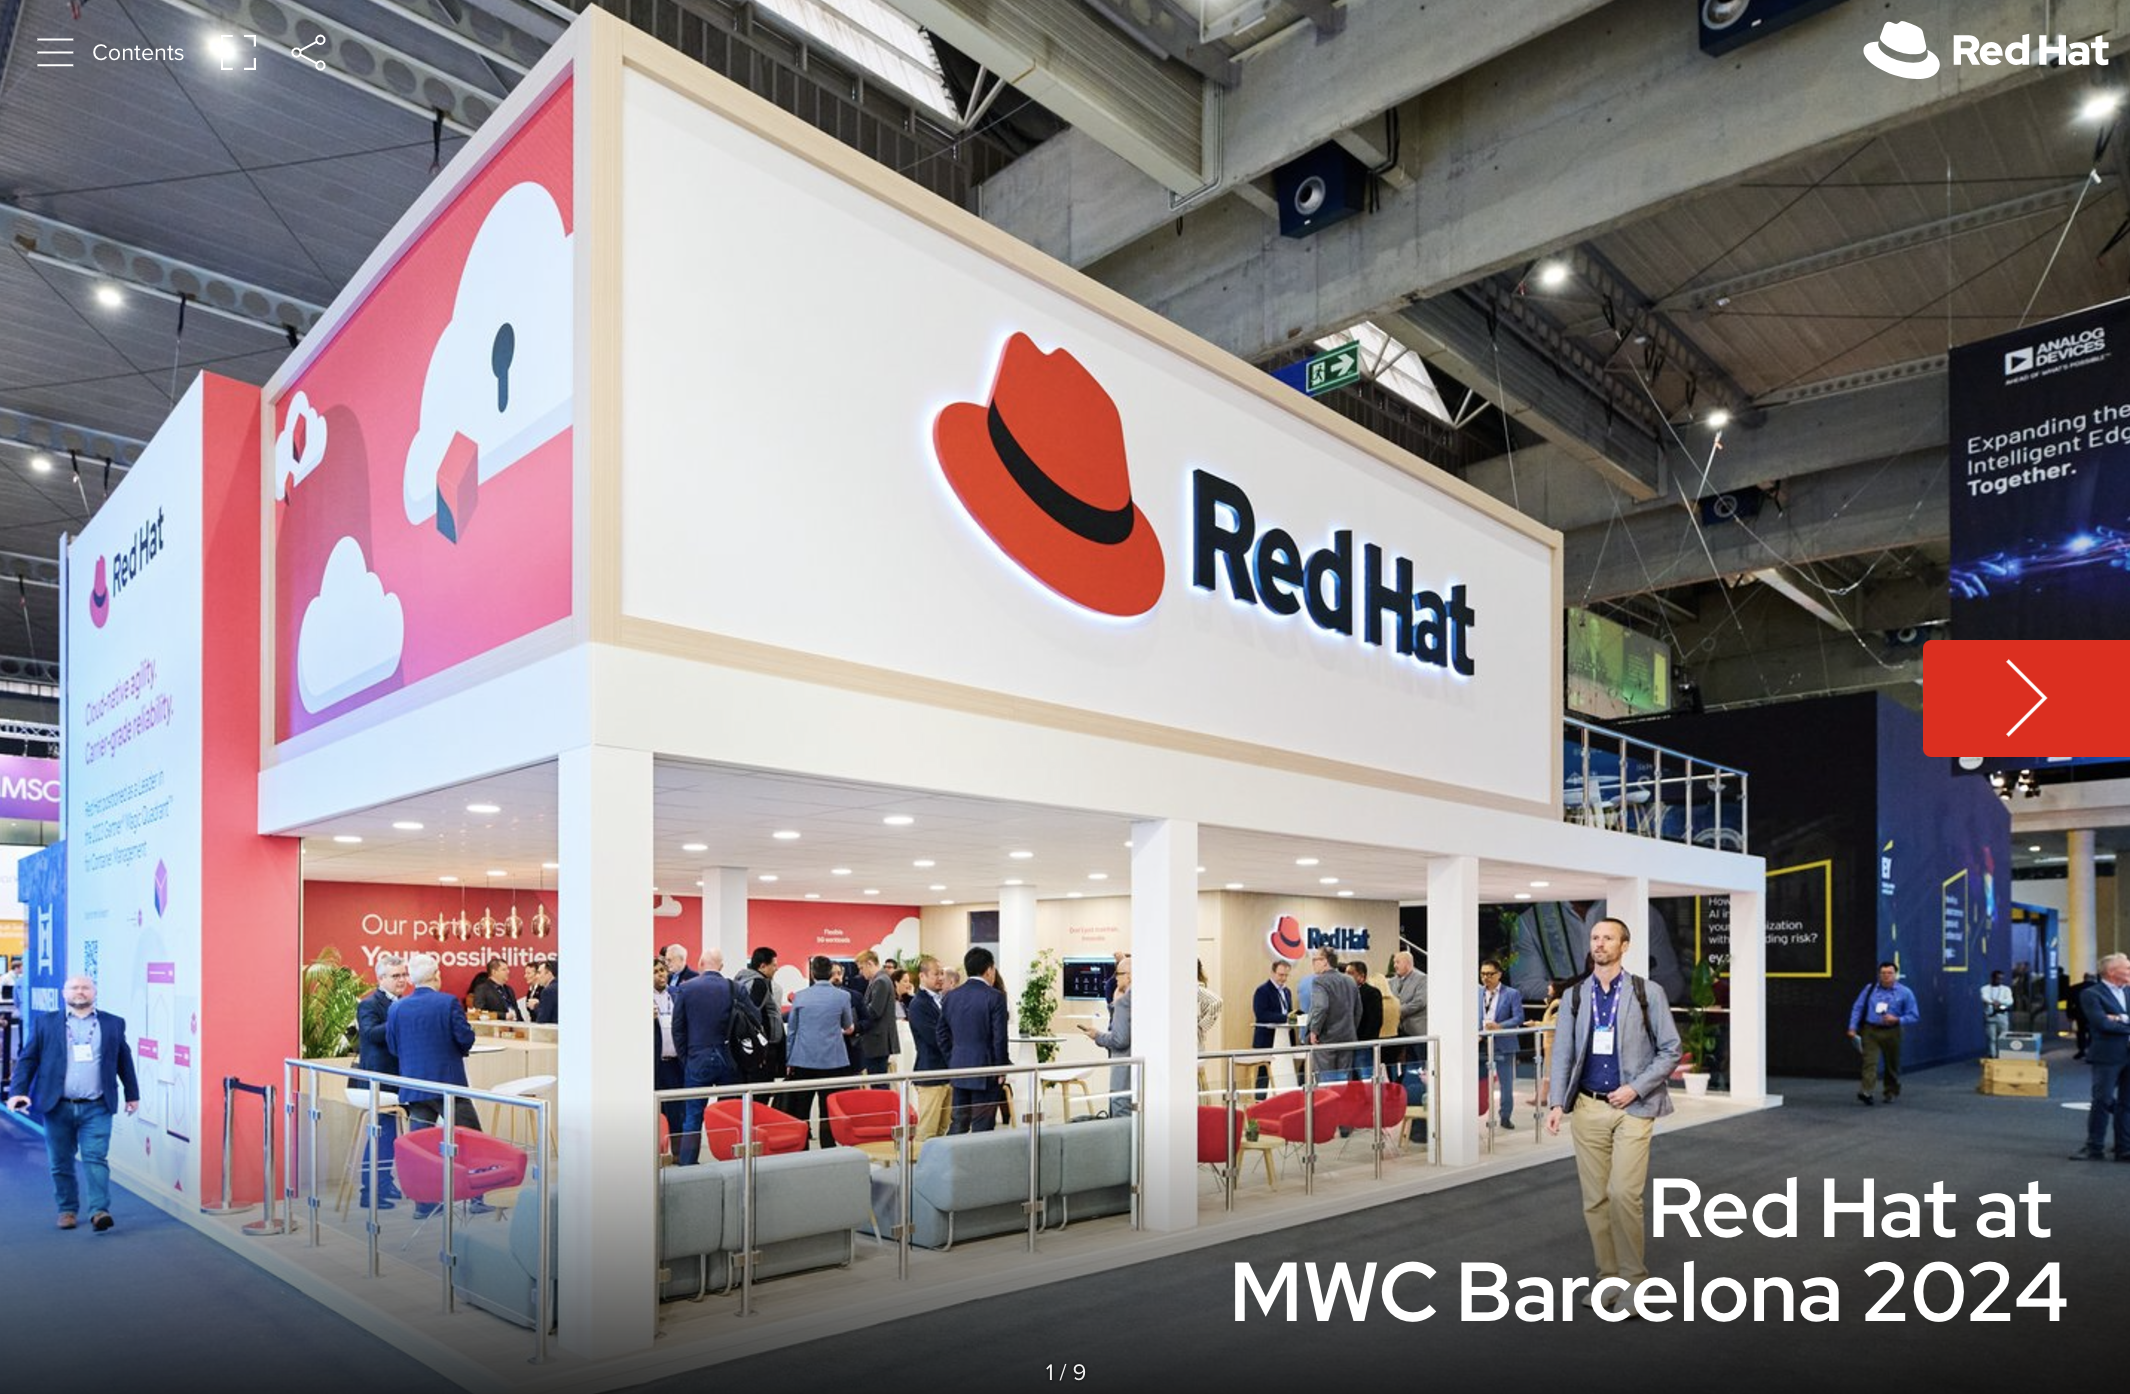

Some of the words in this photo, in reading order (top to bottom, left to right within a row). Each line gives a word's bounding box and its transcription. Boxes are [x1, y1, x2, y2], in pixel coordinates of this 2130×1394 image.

[2036, 327, 2105, 355] ANALOG
[2036, 338, 2106, 367] DEVICES
[2004, 374, 2029, 386] AHEAD
[1967, 415, 2086, 455] Expanding
[2093, 404, 2130, 424] the
[1967, 436, 2081, 476] Intelligent
[1967, 463, 2077, 497] Together.
[113, 531, 137, 598] Red
[139, 506, 164, 572] Hat
[1193, 468, 1353, 636] Red
[1364, 542, 1475, 676] Hat
[85, 679, 130, 727] Cloud-native
[130, 658, 157, 701] agility.
[85, 716, 132, 766] Carrier-grade
[132, 692, 173, 738] reliability.
[361, 913, 407, 936] Our
[1307, 927, 1341, 949] Red
[1341, 928, 1370, 950] Hat
[1791, 933, 1818, 943] risk?
